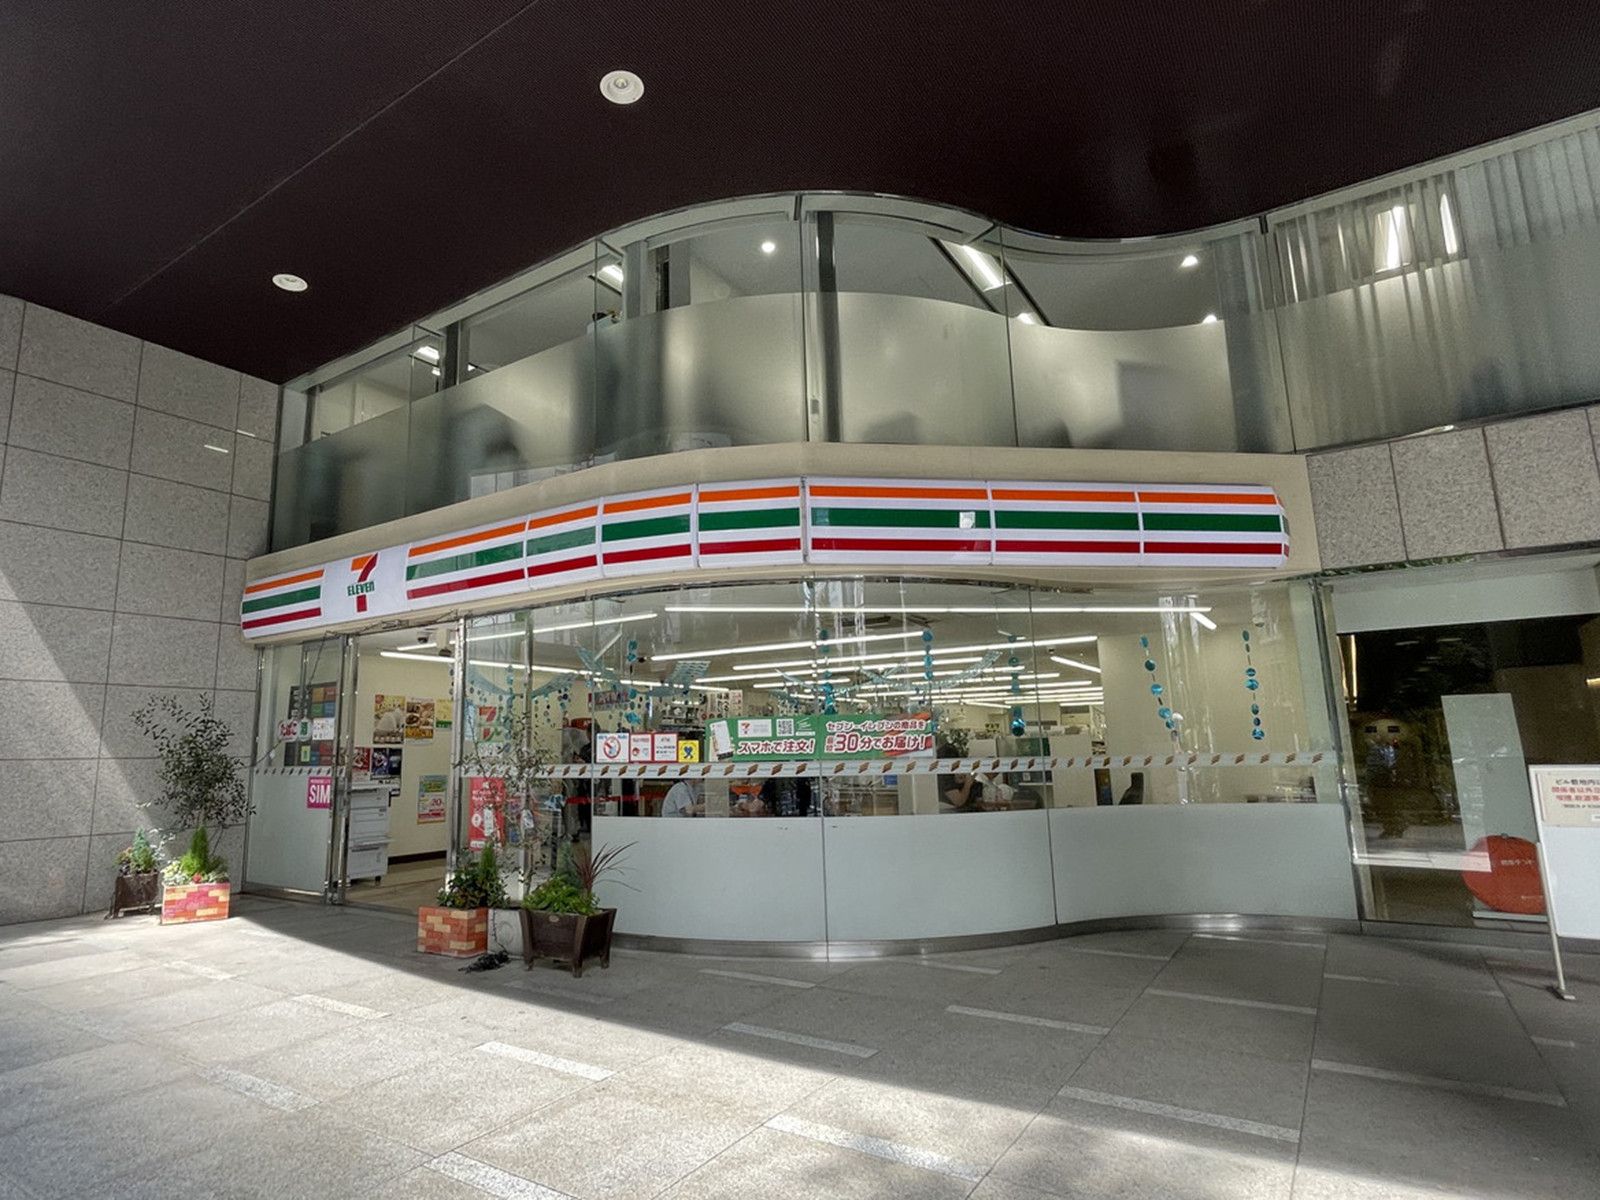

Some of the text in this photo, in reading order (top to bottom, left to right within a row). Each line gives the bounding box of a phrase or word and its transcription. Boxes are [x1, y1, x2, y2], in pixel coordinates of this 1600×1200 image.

[738, 739, 815, 754] スマホで注文!
[309, 784, 331, 804] SIM
